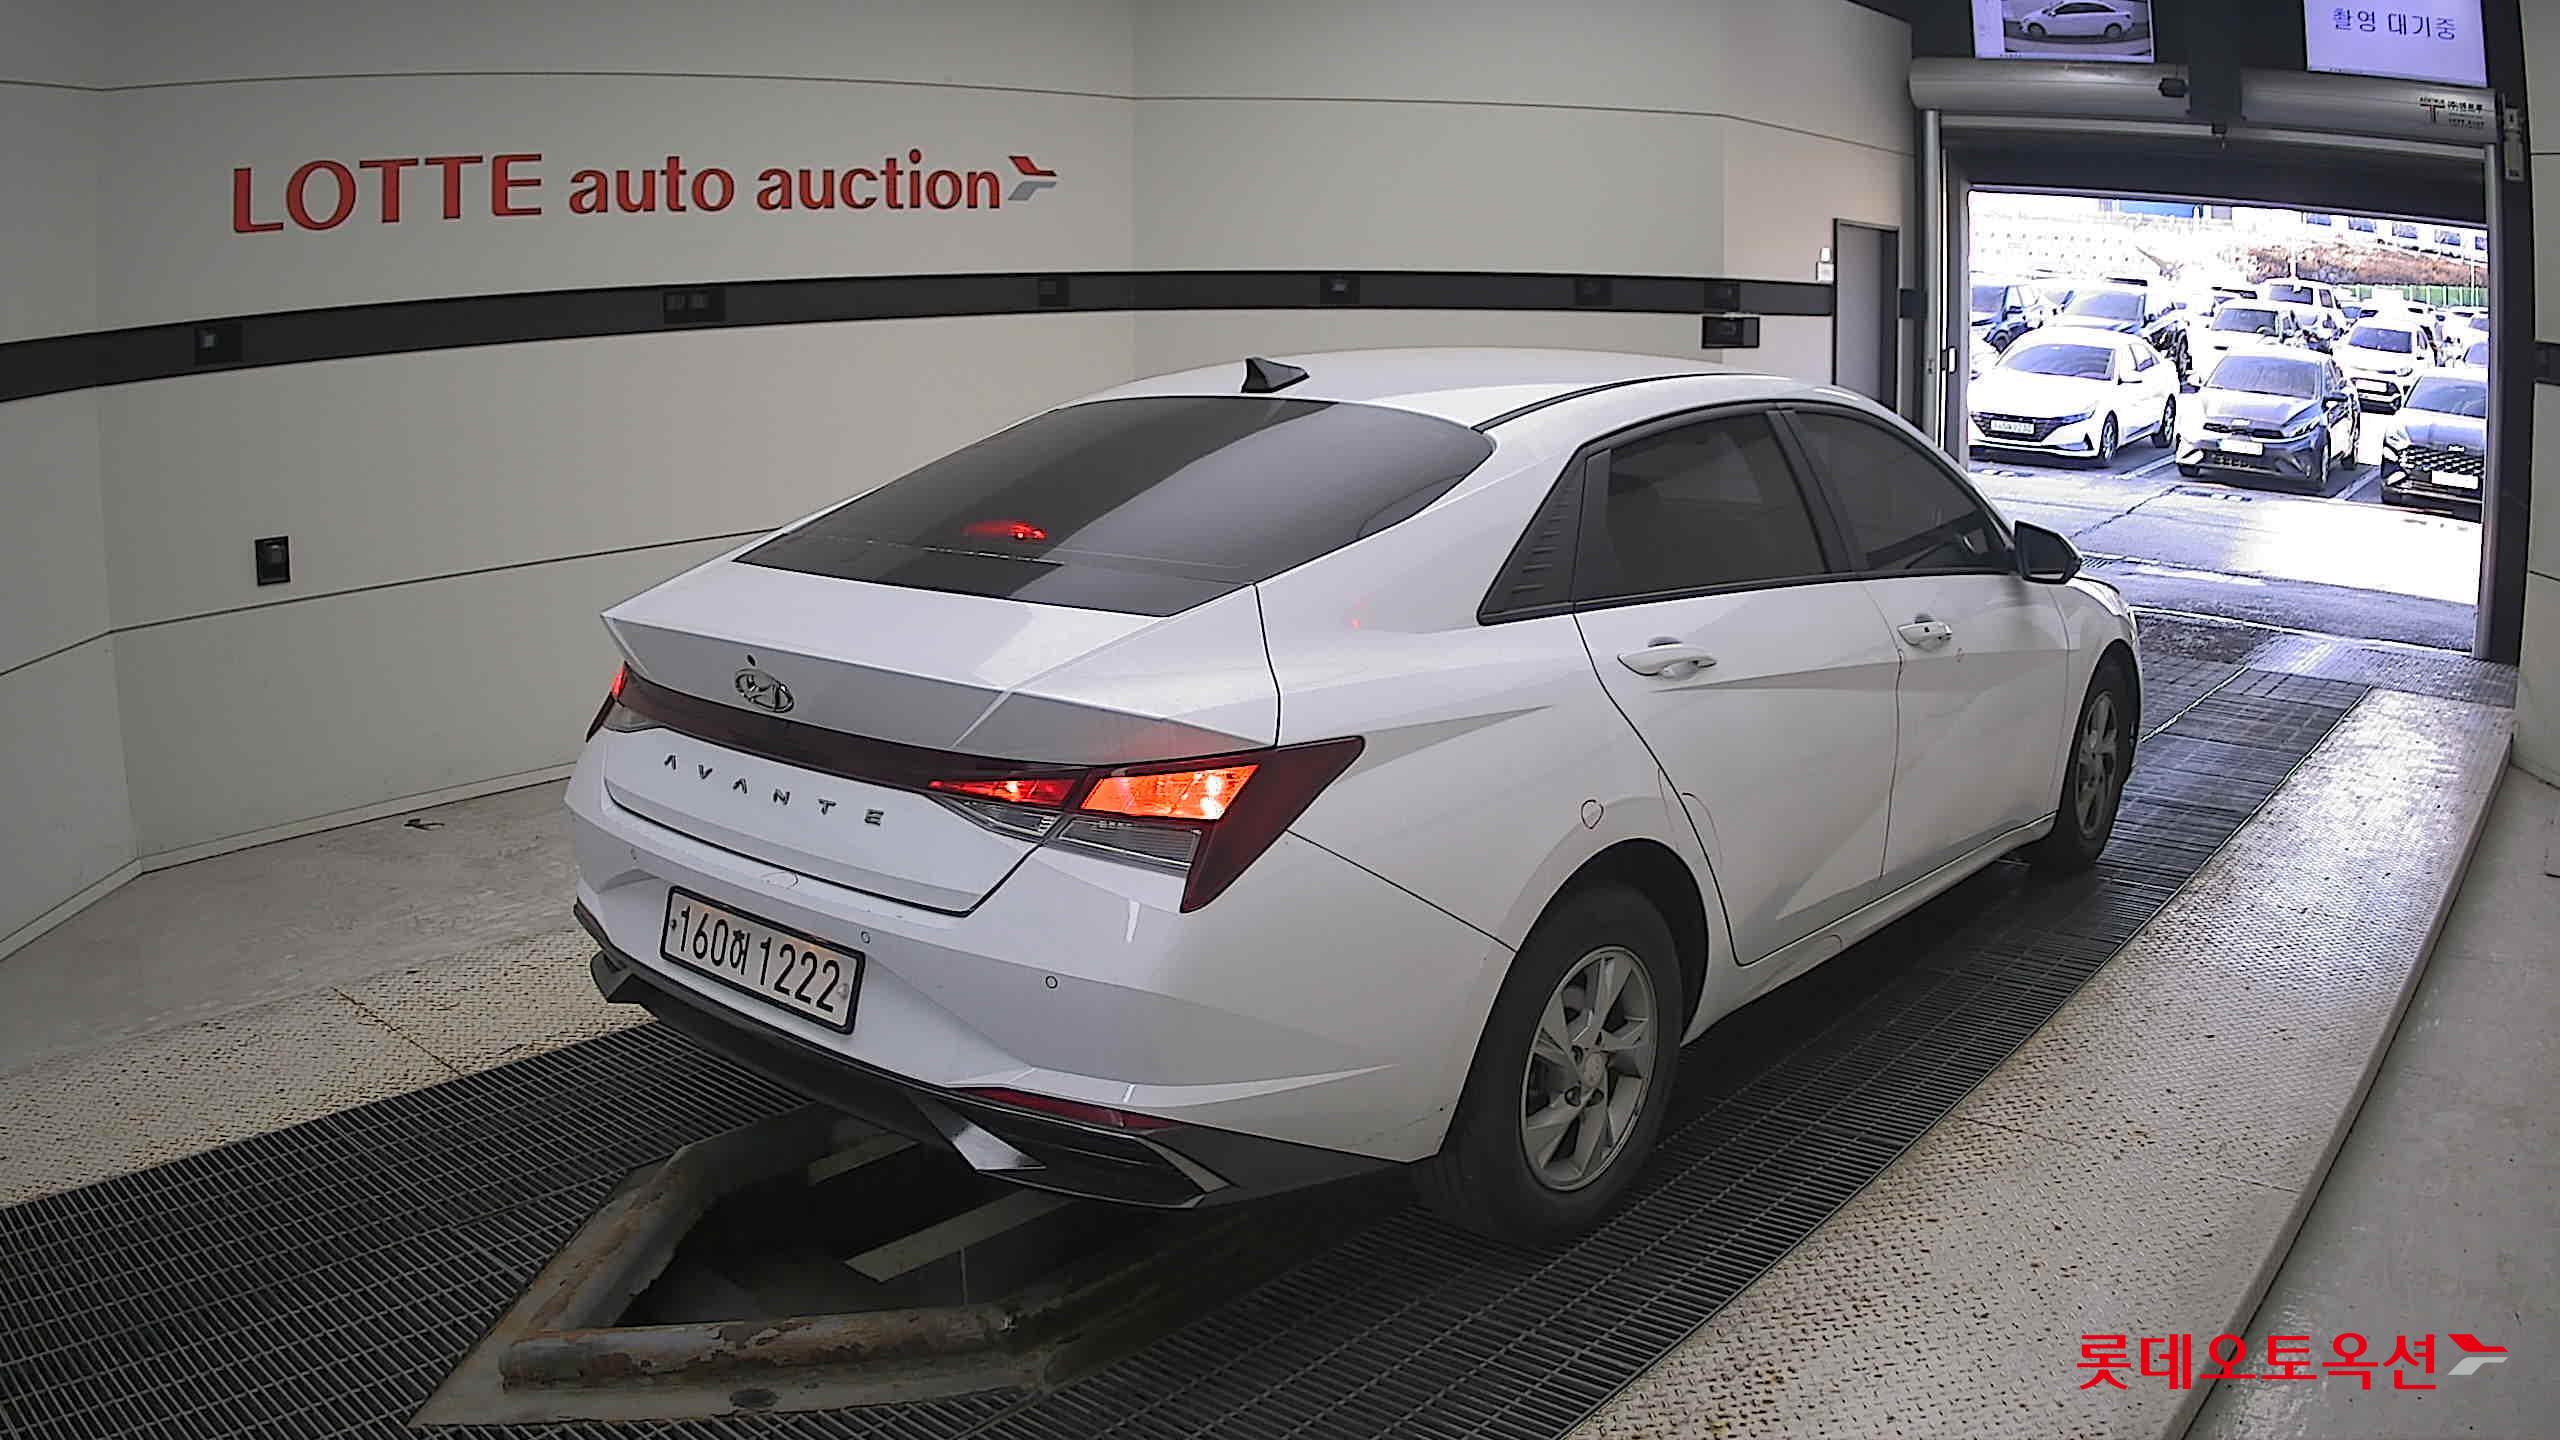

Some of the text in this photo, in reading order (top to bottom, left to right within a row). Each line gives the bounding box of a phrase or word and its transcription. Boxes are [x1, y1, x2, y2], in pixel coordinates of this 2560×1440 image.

[2333, 7, 2457, 41] 촬영 대기중
[233, 150, 1003, 233] LOTTE auto auction
[663, 754, 885, 826] AVANTE
[680, 905, 841, 1013] 160허 1222
